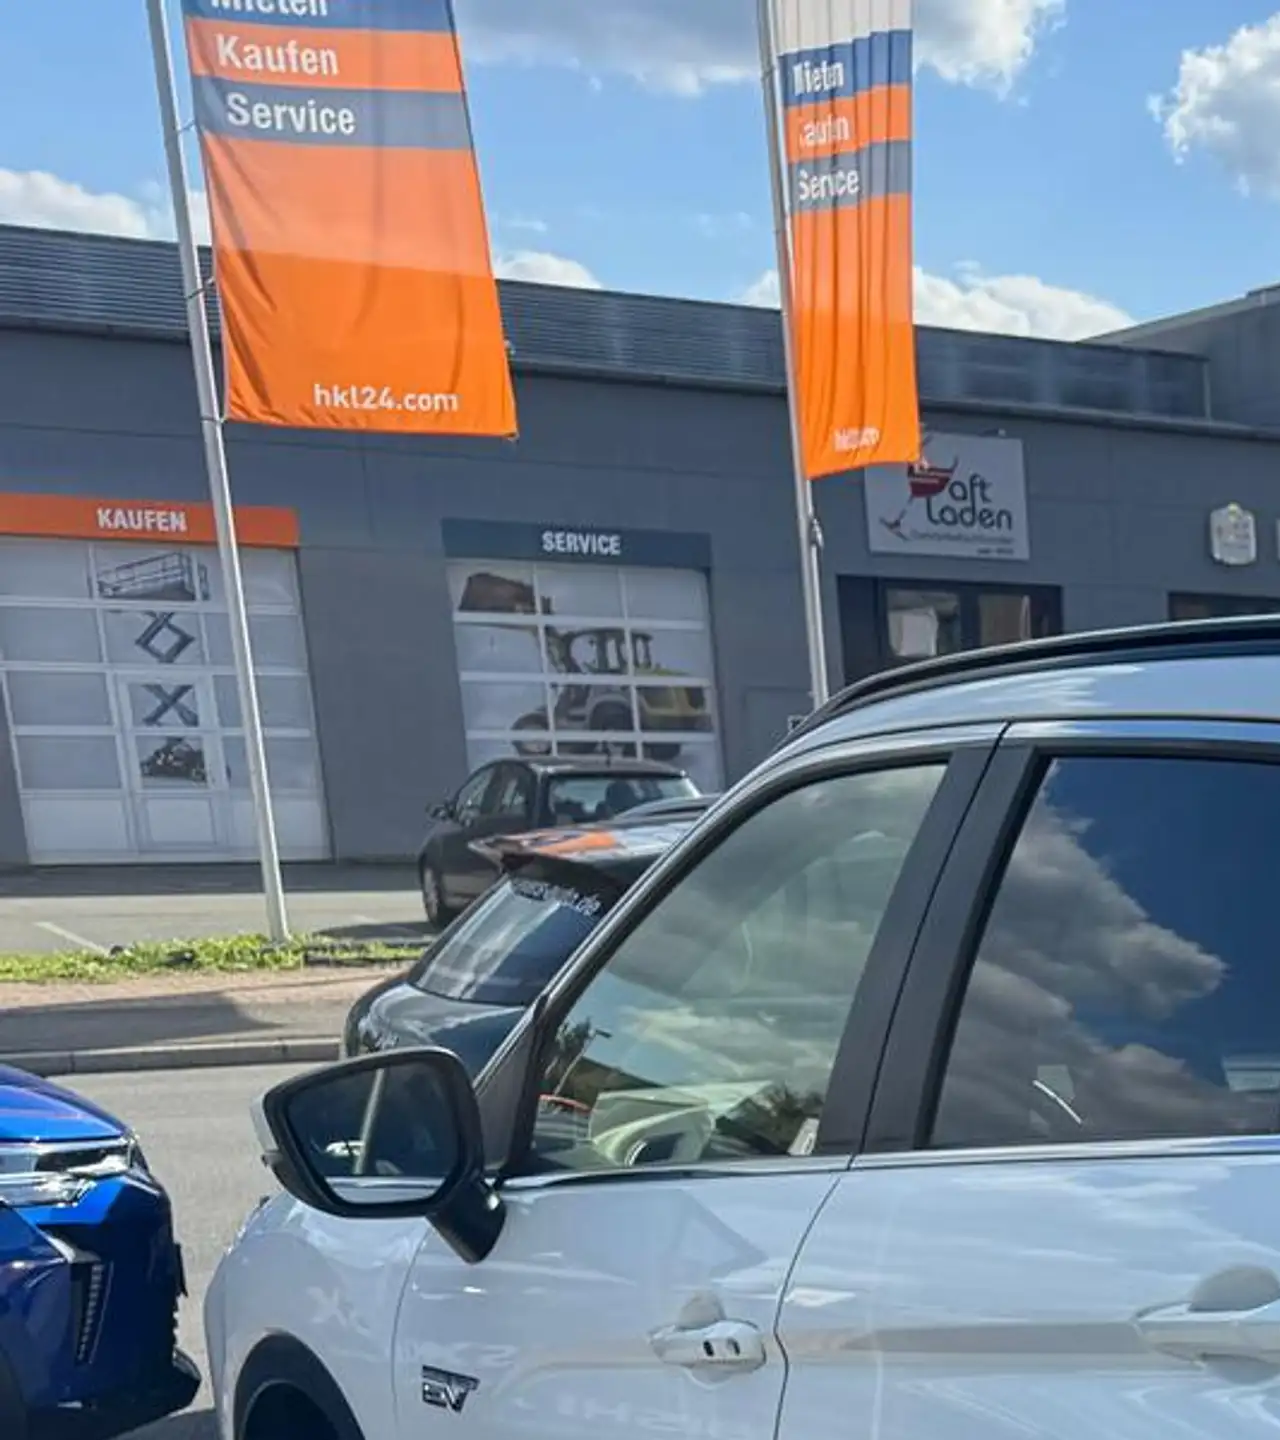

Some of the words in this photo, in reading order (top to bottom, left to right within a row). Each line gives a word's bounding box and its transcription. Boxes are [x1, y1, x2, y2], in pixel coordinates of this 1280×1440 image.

[215, 33, 340, 76] Kaufen
[227, 92, 356, 135] Service
[313, 383, 458, 412] hkl24.com
[97, 508, 187, 532] KAUFEN
[542, 531, 621, 555] SERVICE
